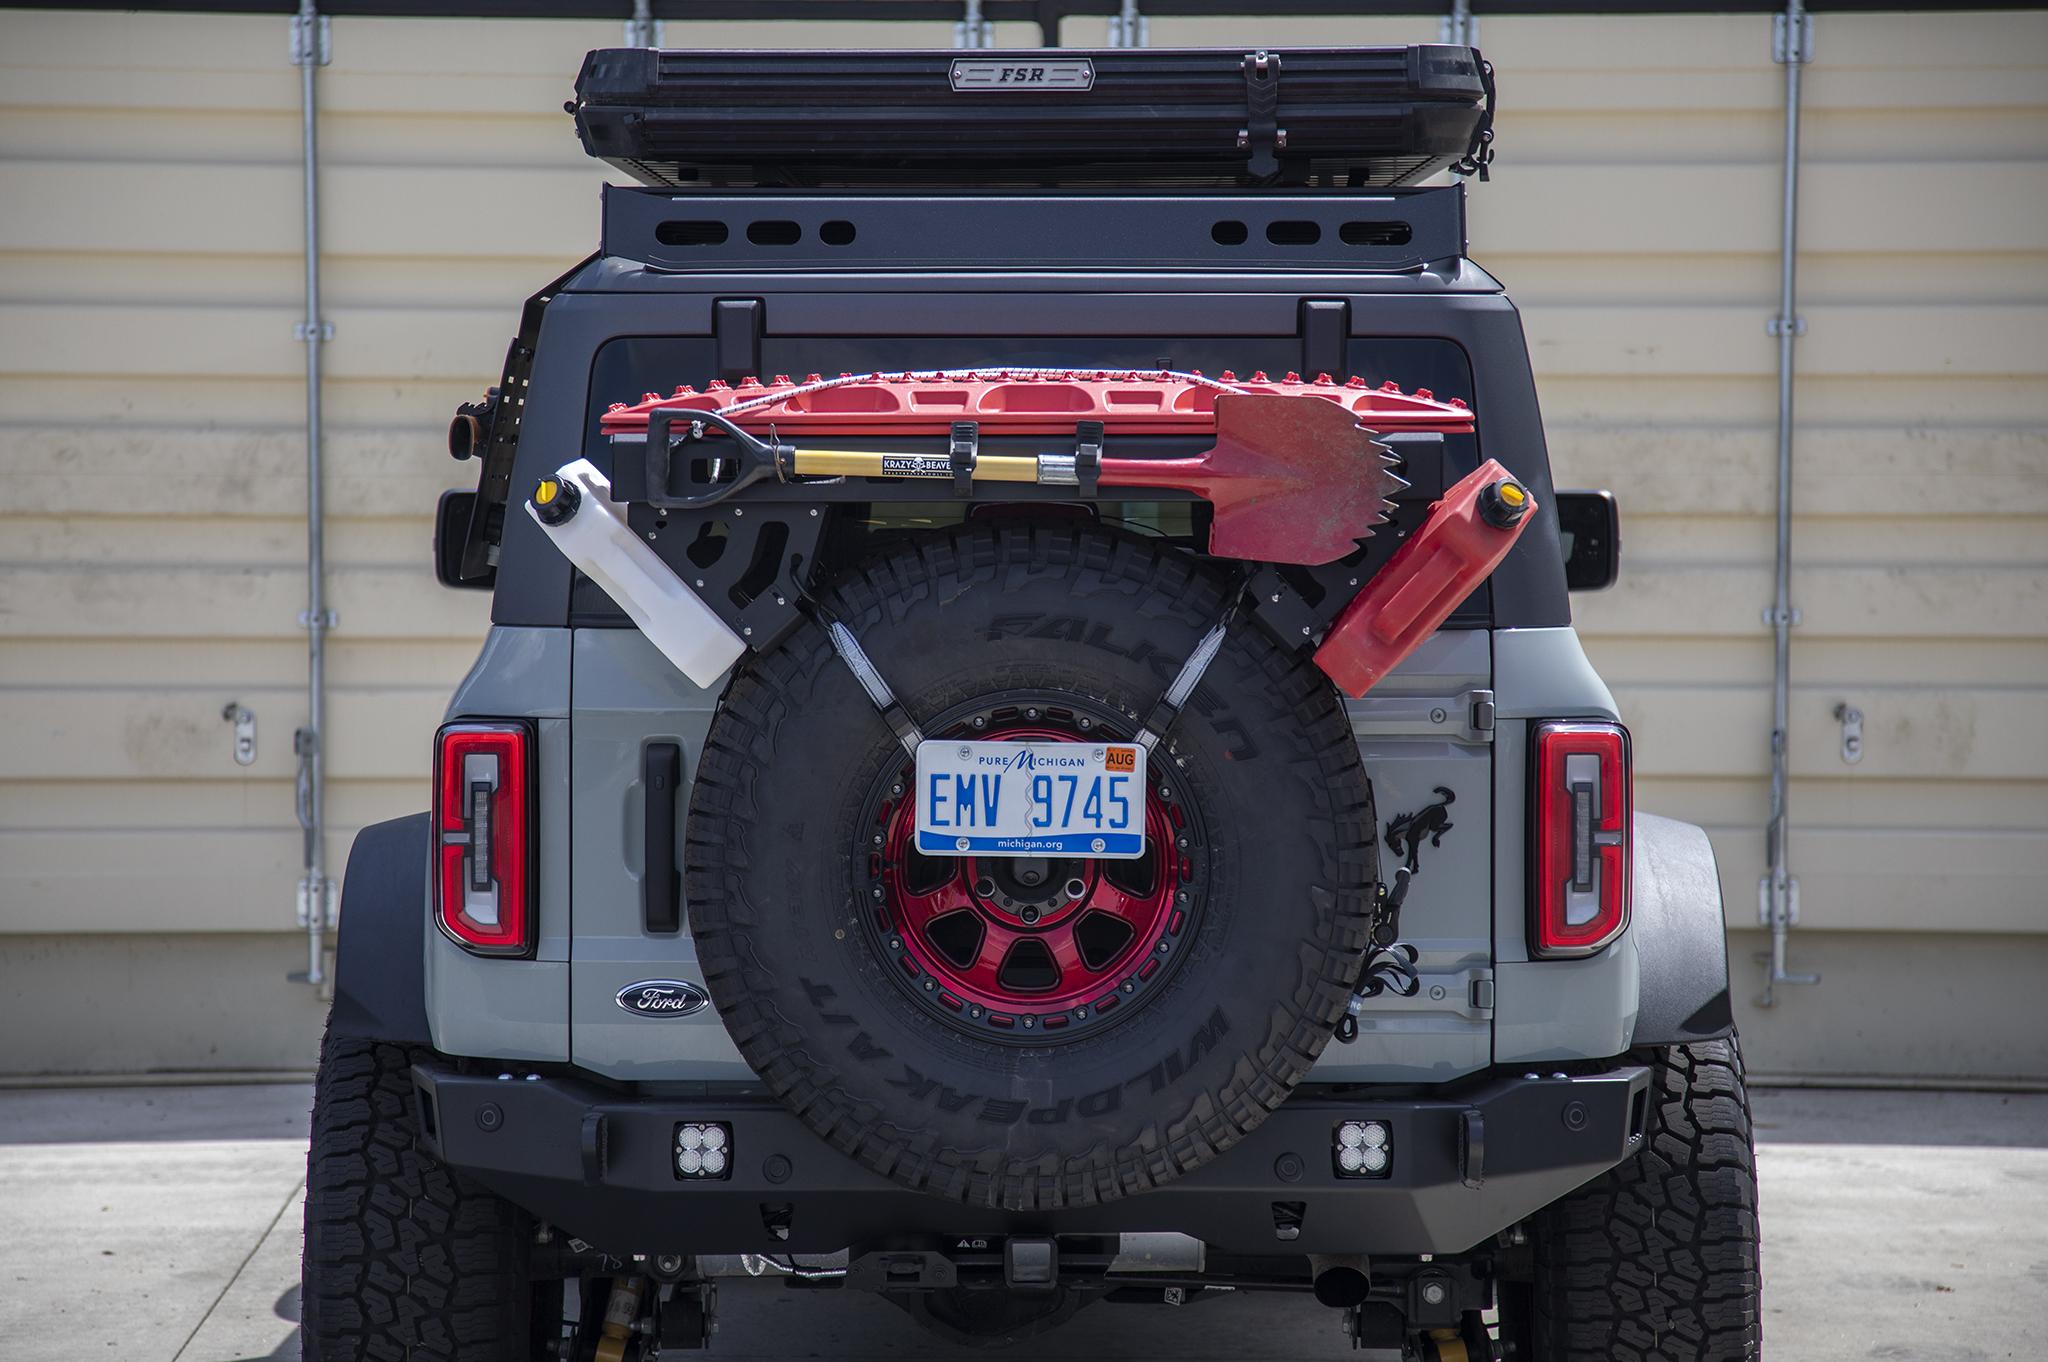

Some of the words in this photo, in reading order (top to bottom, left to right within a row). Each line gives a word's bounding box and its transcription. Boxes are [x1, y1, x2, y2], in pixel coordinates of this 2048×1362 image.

[999, 68, 1045, 82] FSR
[884, 460, 912, 469] KRAZY
[926, 461, 951, 470] BEAVE
[979, 756, 1009, 766] PURE
[1003, 750, 1085, 774] MICHIGAN
[1107, 752, 1135, 766] AUG
[929, 773, 1001, 827] EMV
[1032, 775, 1129, 829] 9745
[997, 838, 1063, 851] michigan.org
[637, 988, 686, 1009] Ford
[883, 1004, 1232, 1125] WILDPEAK
